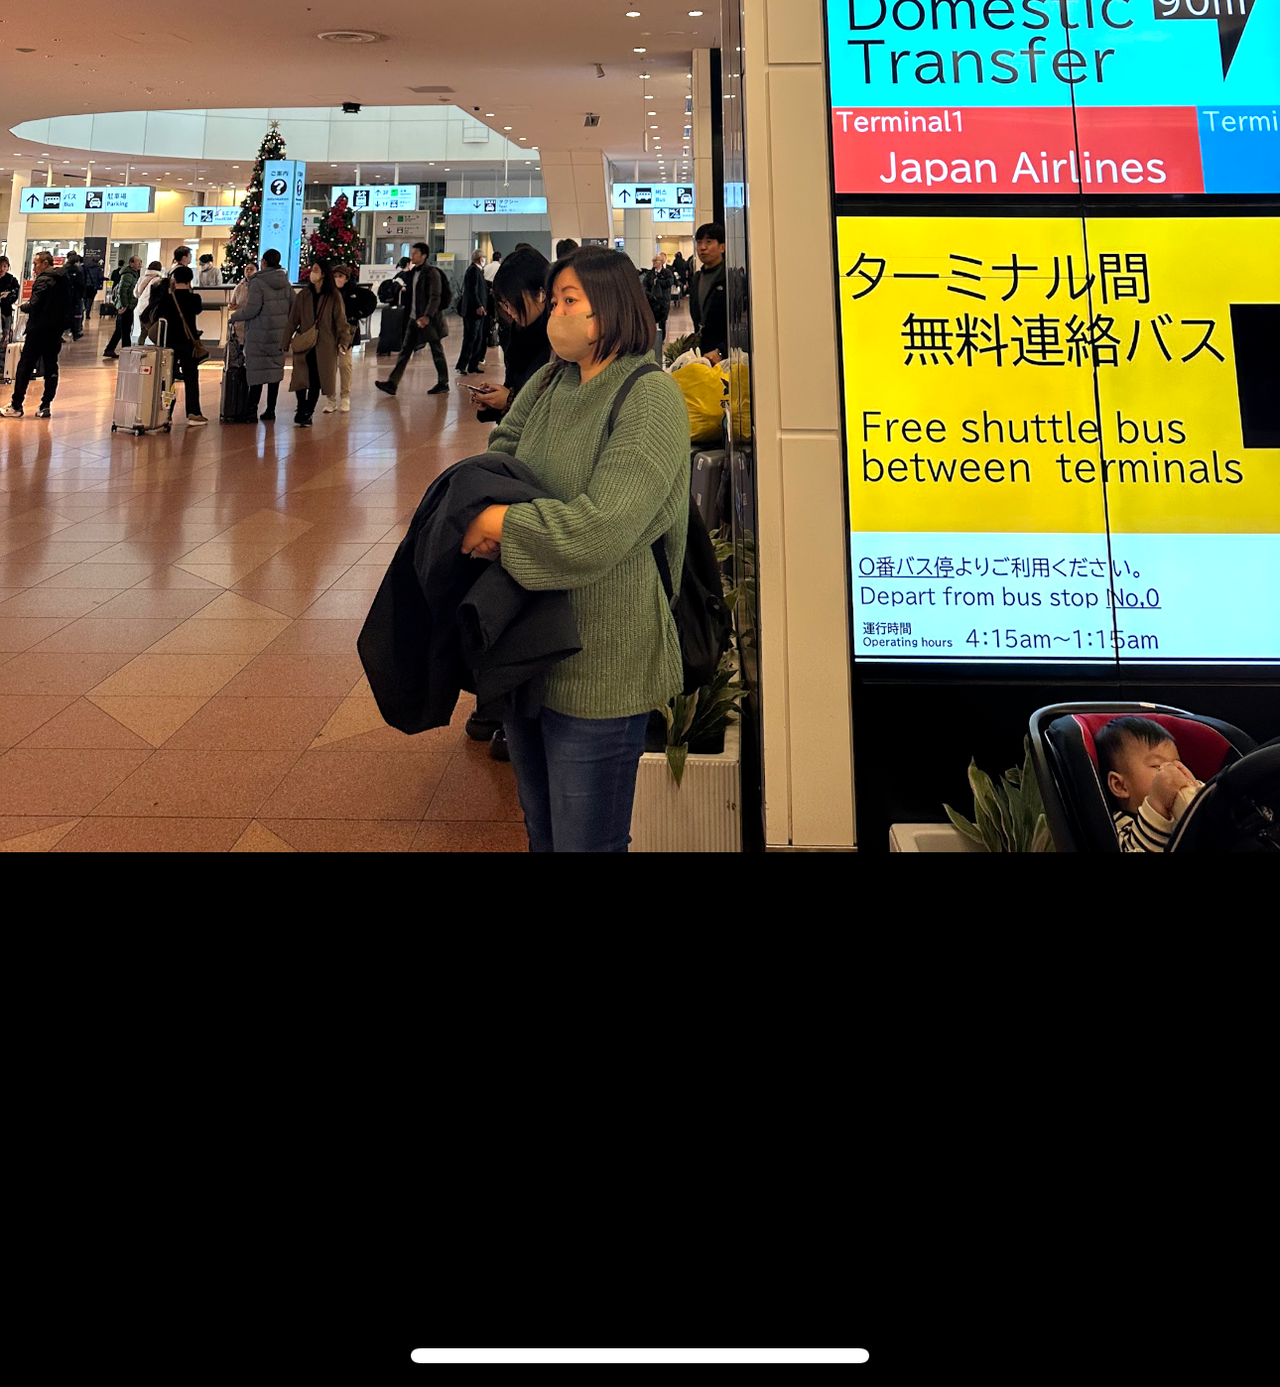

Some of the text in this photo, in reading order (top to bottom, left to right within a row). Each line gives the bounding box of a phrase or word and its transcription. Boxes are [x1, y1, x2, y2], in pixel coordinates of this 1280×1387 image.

[847, 36, 1115, 84] Transfer
[836, 111, 963, 133] Terminal1
[1203, 111, 1280, 132] Termi
[880, 151, 1166, 187] Japan Airlines
[845, 252, 1150, 304] ターミナル間
[900, 312, 1226, 368] 無料連絡バス
[862, 410, 1186, 444] Free shuttle bus
[862, 449, 1244, 484] between terminals
[860, 587, 935, 607] Depart
[942, 587, 994, 606] from
[1002, 587, 1042, 606] bus
[1050, 589, 1098, 609] stop
[862, 622, 912, 635] 運行時間
[862, 637, 953, 649] Operating hours
